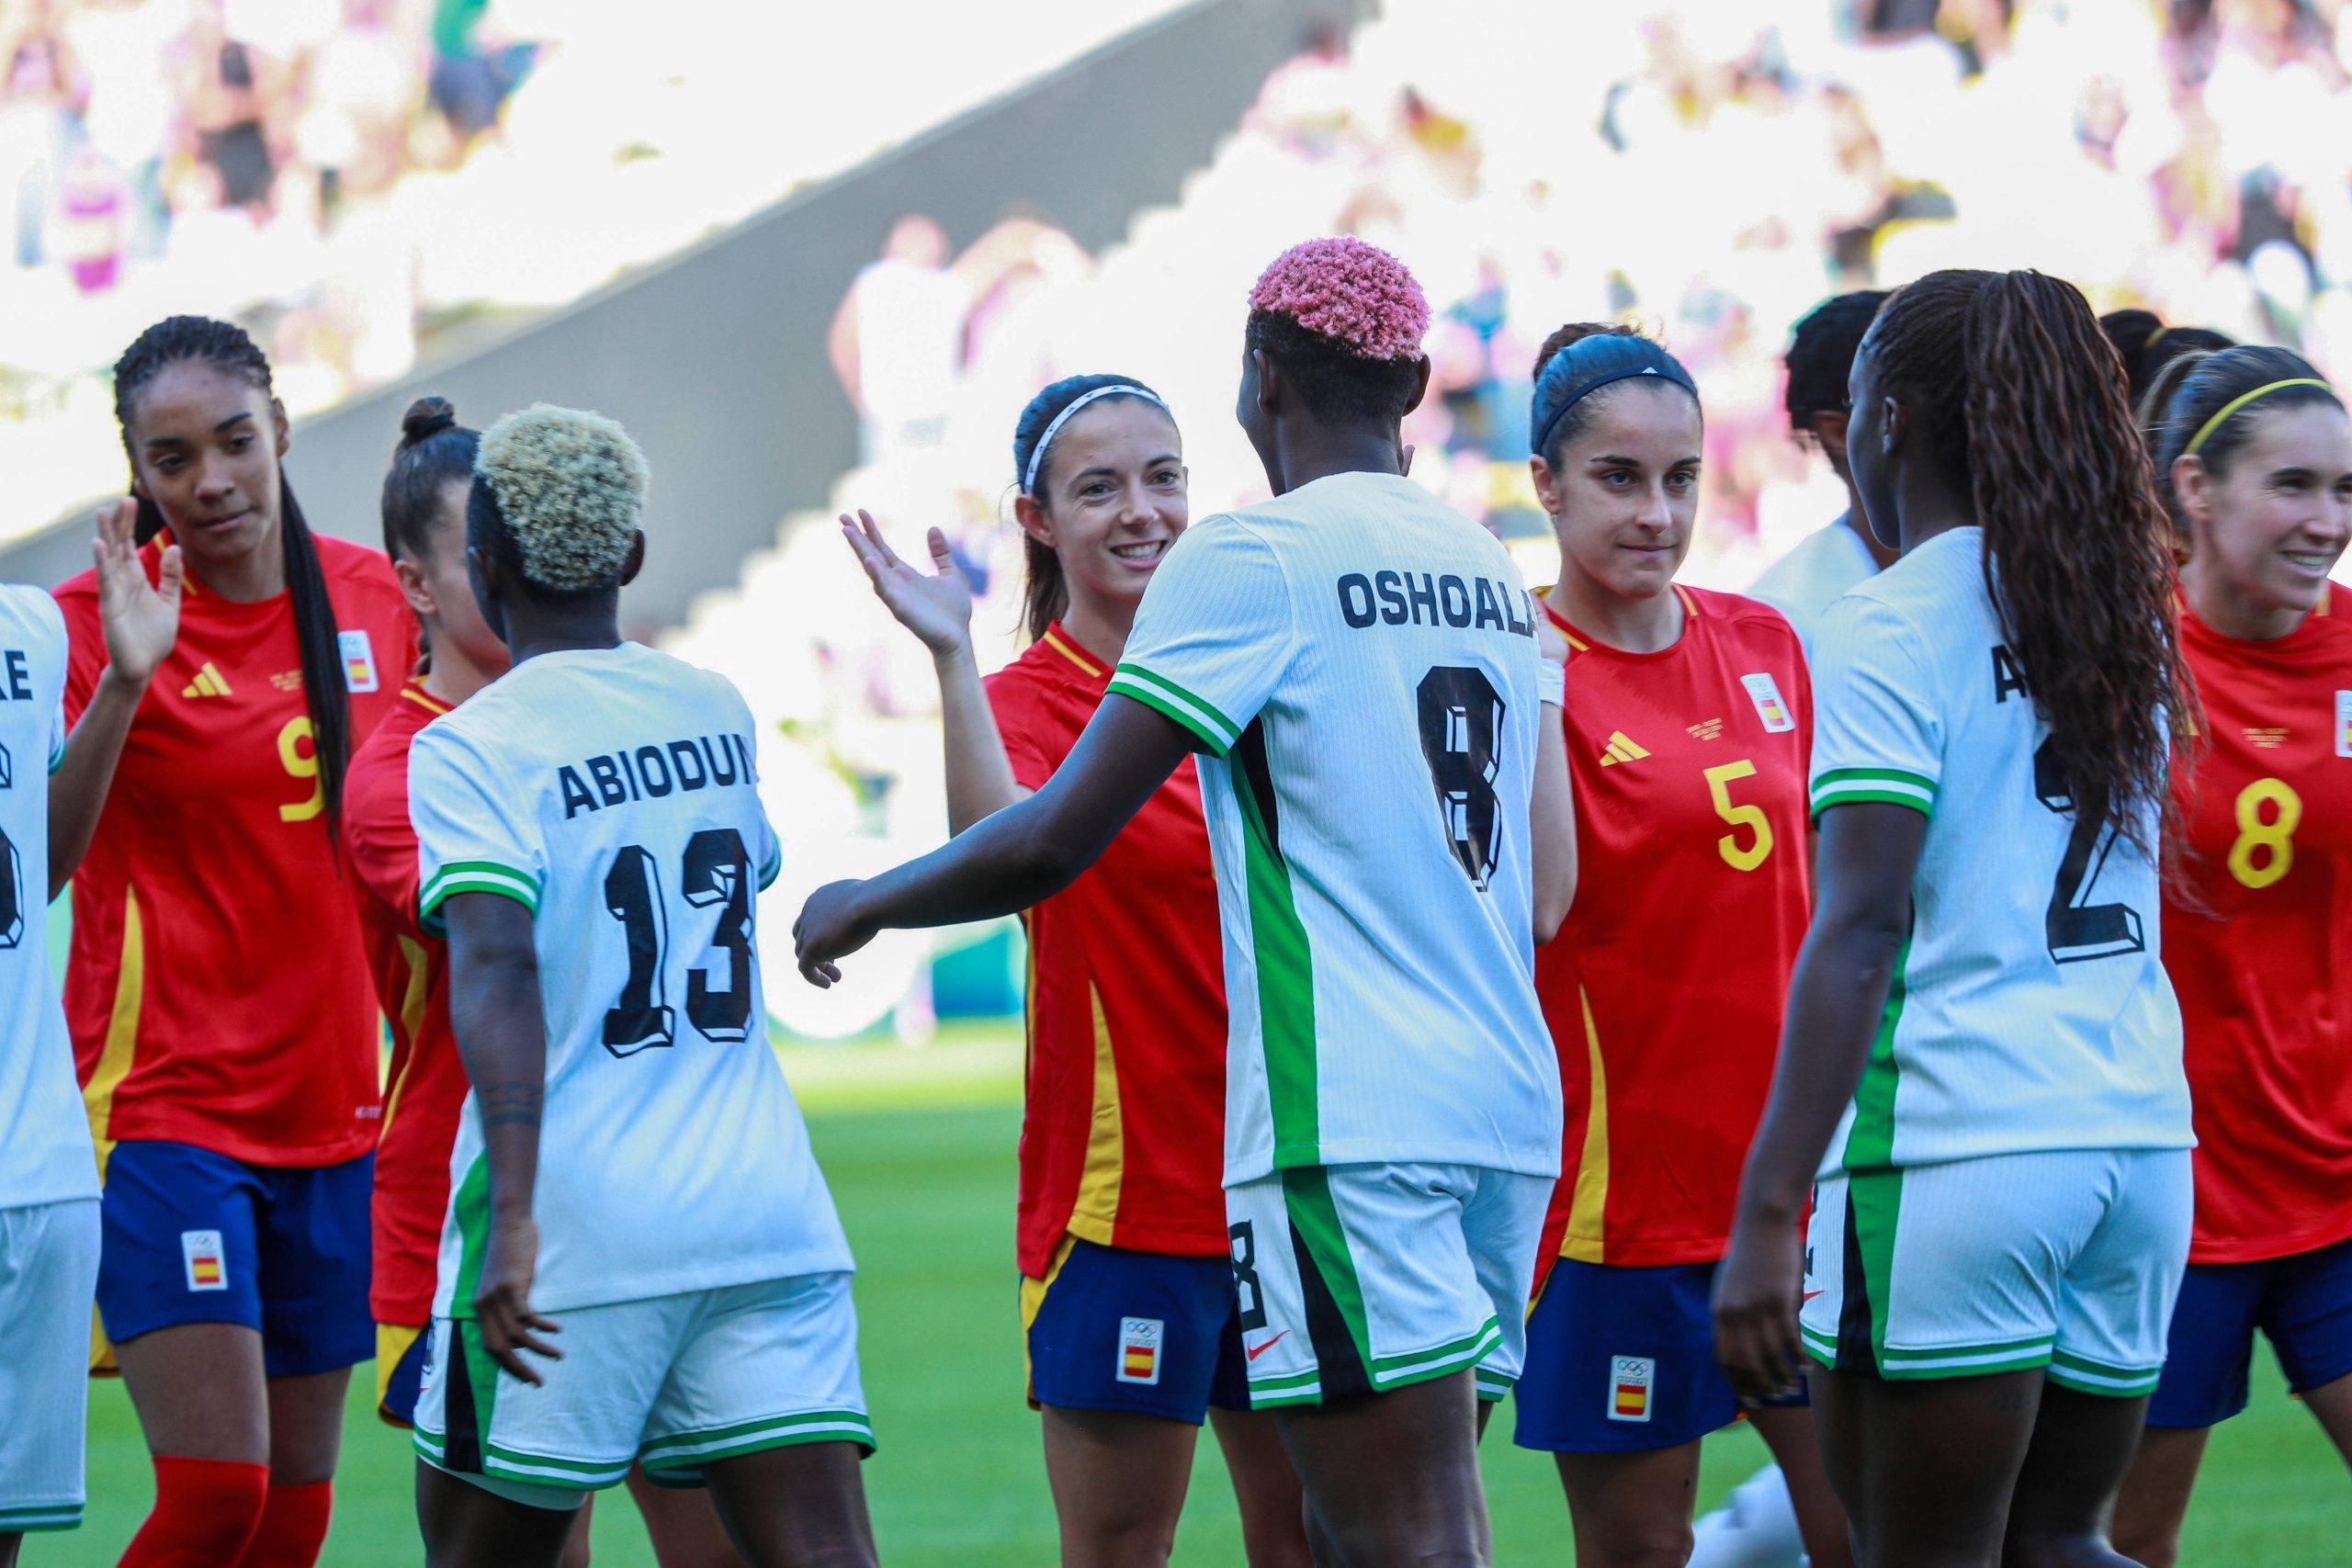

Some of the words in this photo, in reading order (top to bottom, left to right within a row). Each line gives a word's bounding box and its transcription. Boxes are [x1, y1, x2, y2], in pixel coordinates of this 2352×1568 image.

[277, 716, 325, 822] 9
[1417, 666, 1506, 893] 8
[1703, 759, 1773, 871] 5
[2227, 777, 2302, 888] 8
[603, 829, 754, 1058] 13
